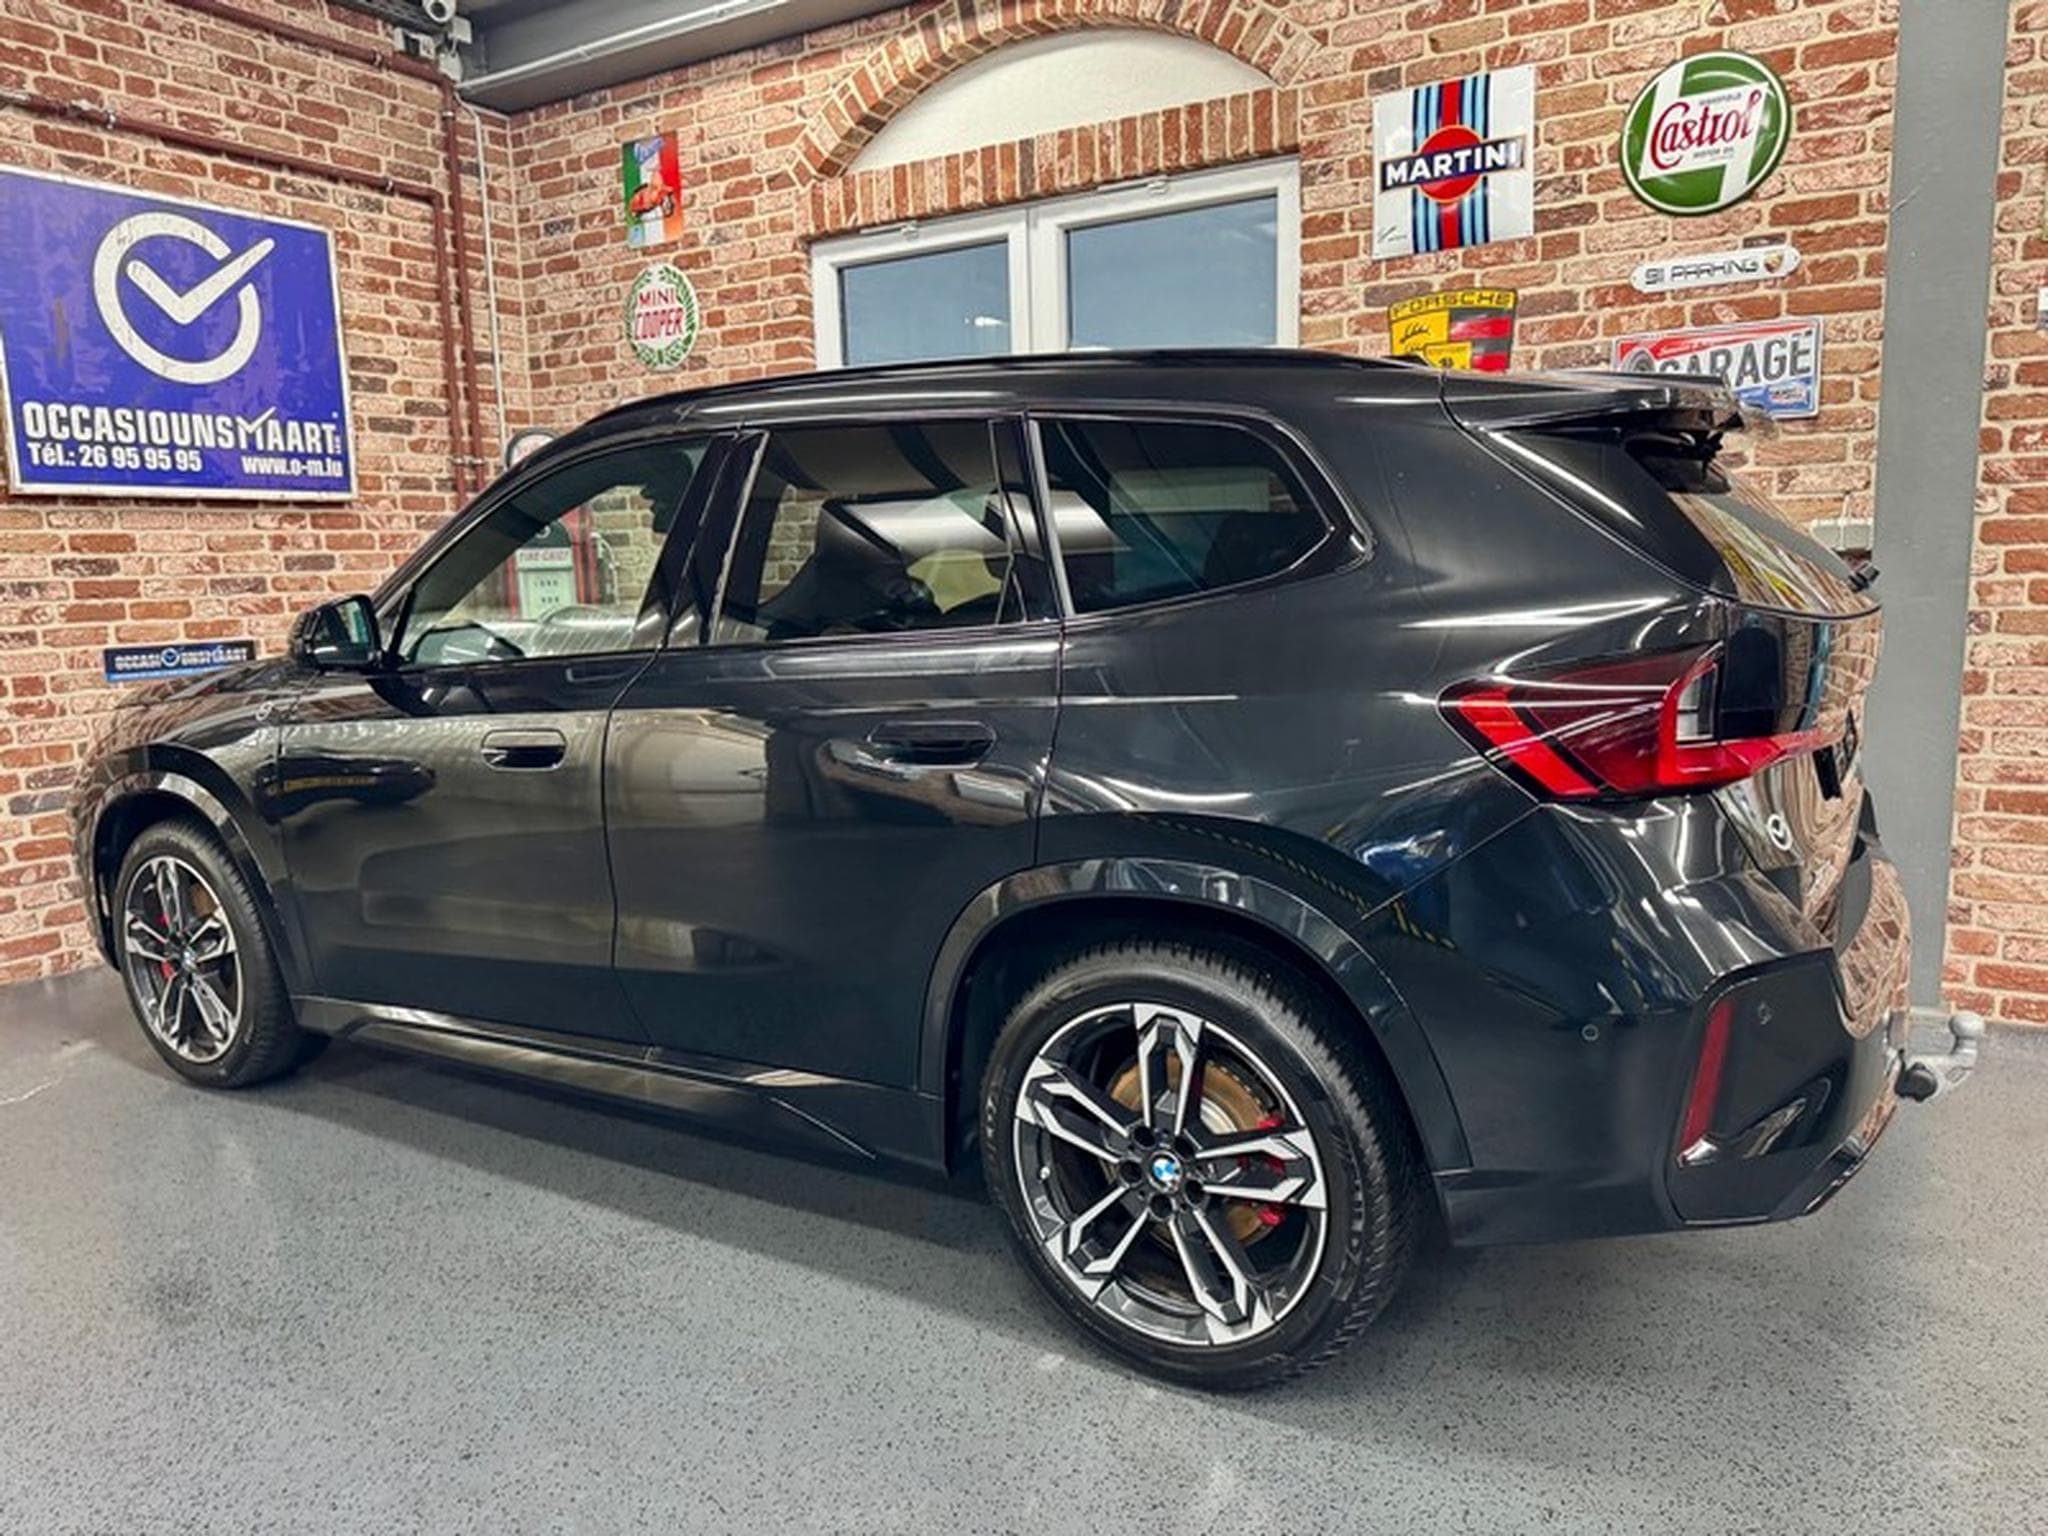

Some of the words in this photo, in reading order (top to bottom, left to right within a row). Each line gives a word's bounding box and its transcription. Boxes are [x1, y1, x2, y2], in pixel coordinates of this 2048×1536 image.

[1650, 89, 1762, 170] Castrol
[1386, 142, 1517, 187] MARTINI
[1671, 258, 1759, 282] PARKING
[638, 288, 675, 305] MINI
[1392, 290, 1511, 317] PORSCHE
[635, 307, 684, 340] COOPER
[1659, 330, 1813, 388] RAGE
[22, 401, 336, 454] OCCASIOUNSMAART
[79, 444, 108, 469] 26
[111, 445, 141, 470] 95
[144, 447, 172, 471] 95
[175, 448, 203, 473] 95
[241, 456, 343, 477] www.o-m.lu
